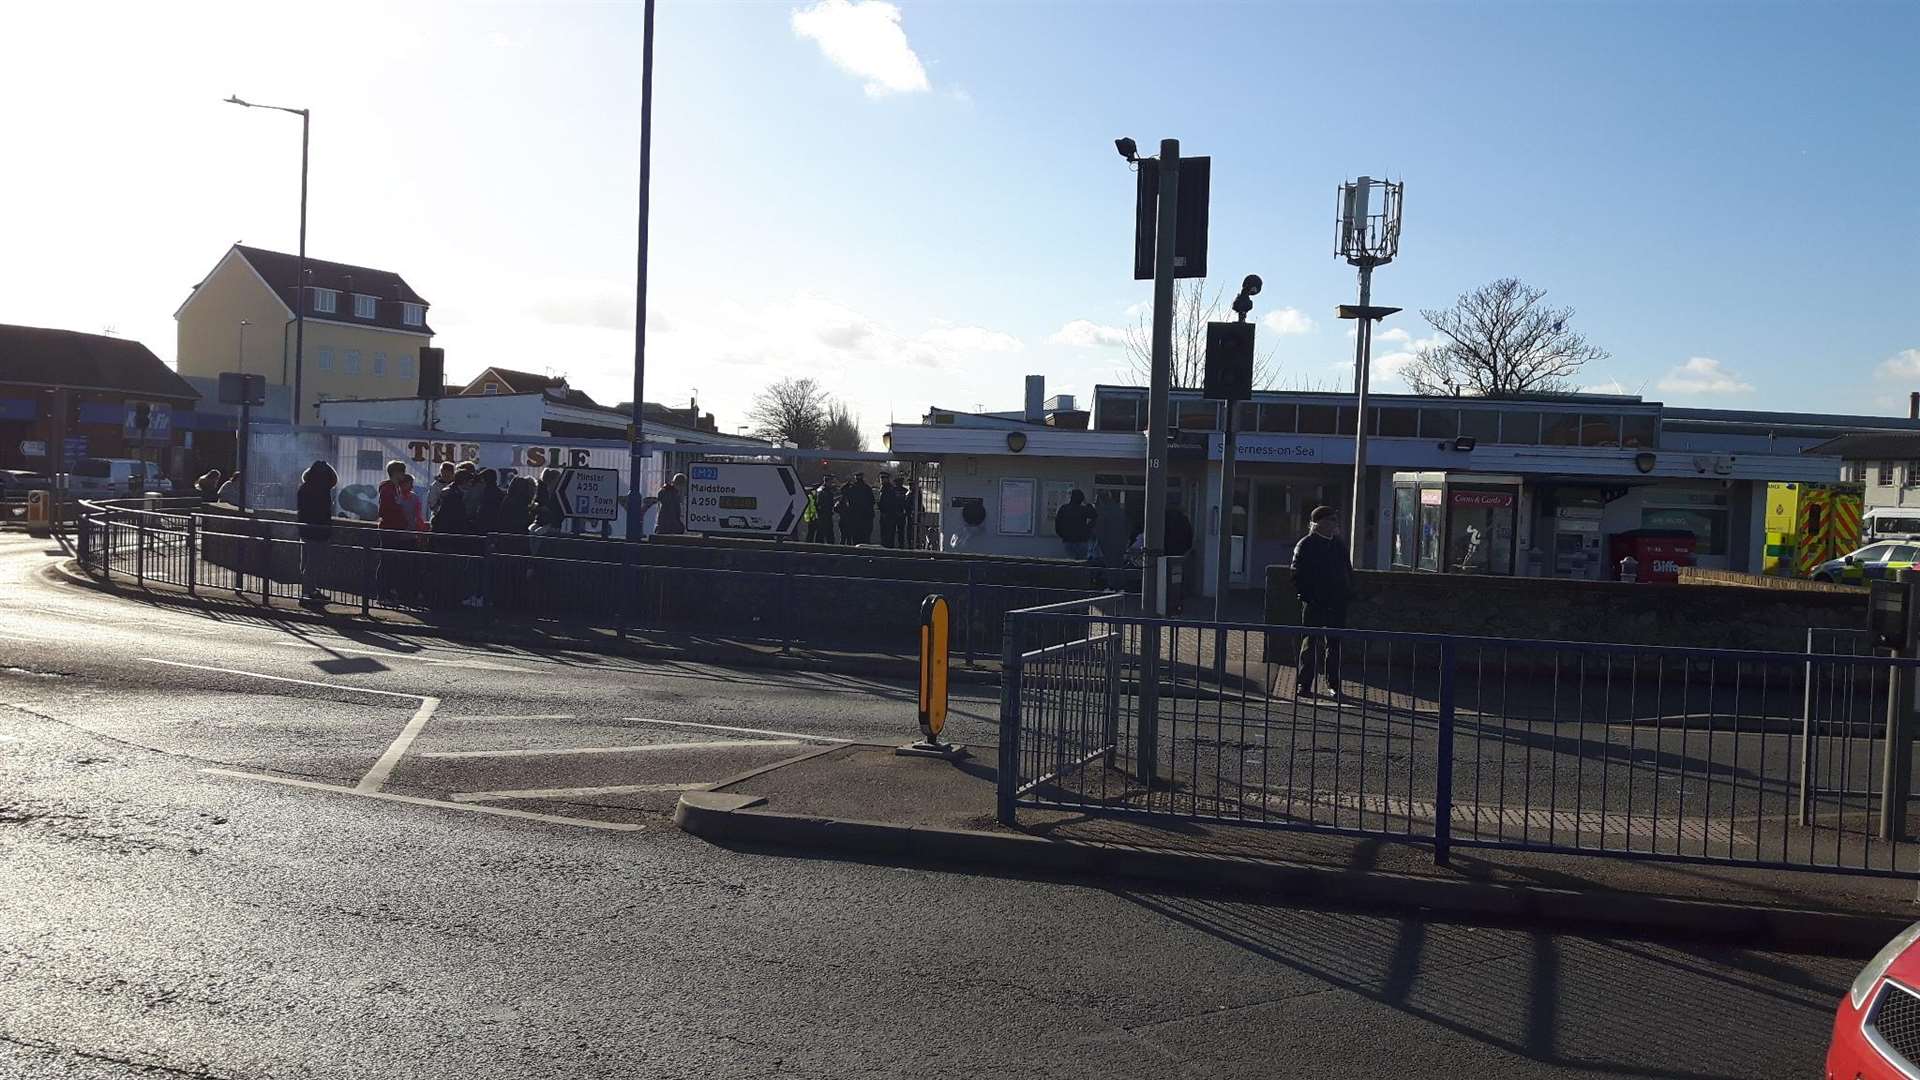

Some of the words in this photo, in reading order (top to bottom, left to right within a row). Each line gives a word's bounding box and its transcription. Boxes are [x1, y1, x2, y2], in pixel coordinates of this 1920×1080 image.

[408, 441, 480, 464] THE
[512, 445, 591, 468] ISLE
[1217, 442, 1315, 457] Serness-on-Sea
[576, 472, 605, 482] Minster
[576, 482, 599, 492] A250
[691, 484, 736, 495] Maidstone
[593, 495, 614, 505] Town
[691, 497, 717, 507] A250
[591, 505, 615, 516] centre
[690, 513, 717, 523] Docks
